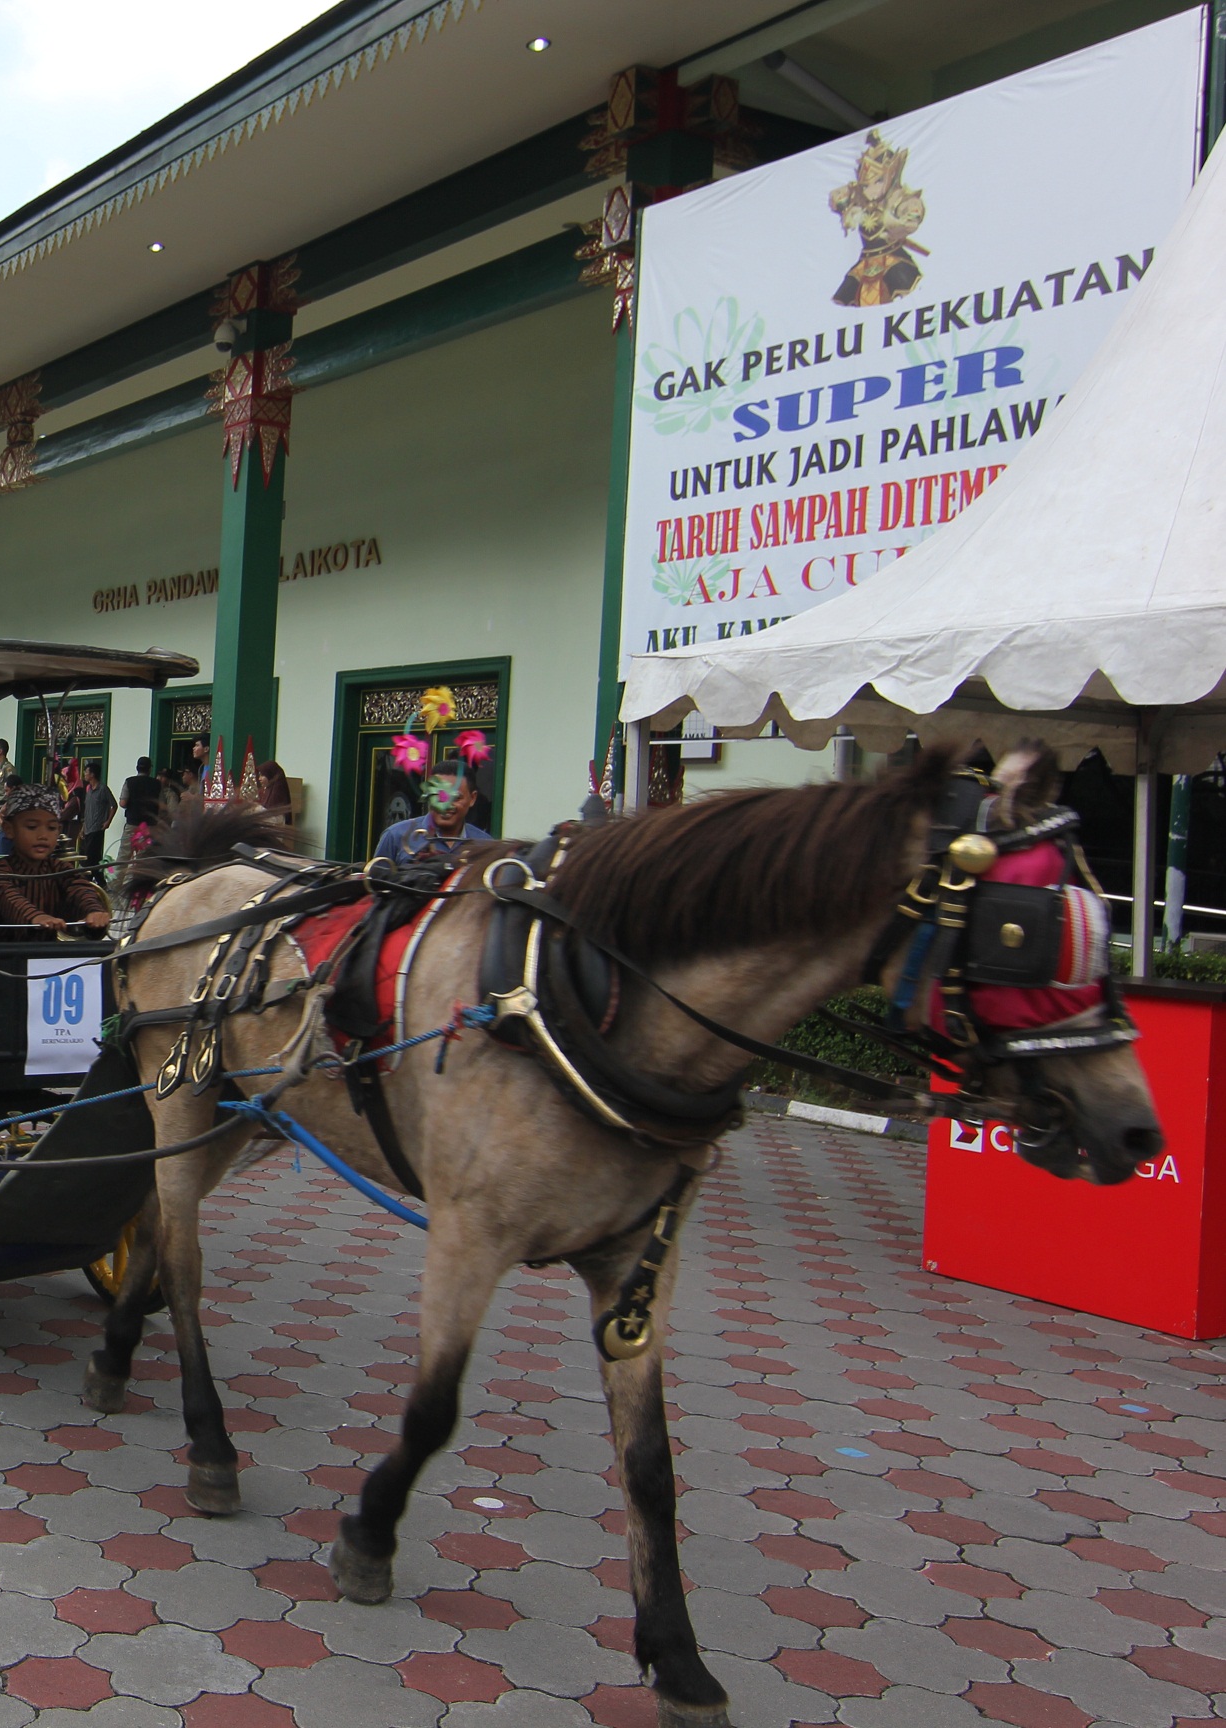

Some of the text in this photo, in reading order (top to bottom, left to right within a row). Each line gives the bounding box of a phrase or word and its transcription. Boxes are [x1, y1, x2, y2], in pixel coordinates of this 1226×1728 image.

[653, 246, 1156, 401] GAK PERLU KEKUATAN
[732, 345, 1025, 443] SUPER
[669, 393, 1066, 501] UNTUK JADI PAHLAW
[656, 506, 742, 564] TARUH
[749, 485, 870, 550] SAMPAH
[92, 583, 139, 614] GRHA
[682, 545, 912, 607] AJA CU
[42, 974, 84, 1025] 09
[54, 1028, 71, 1036] TPA
